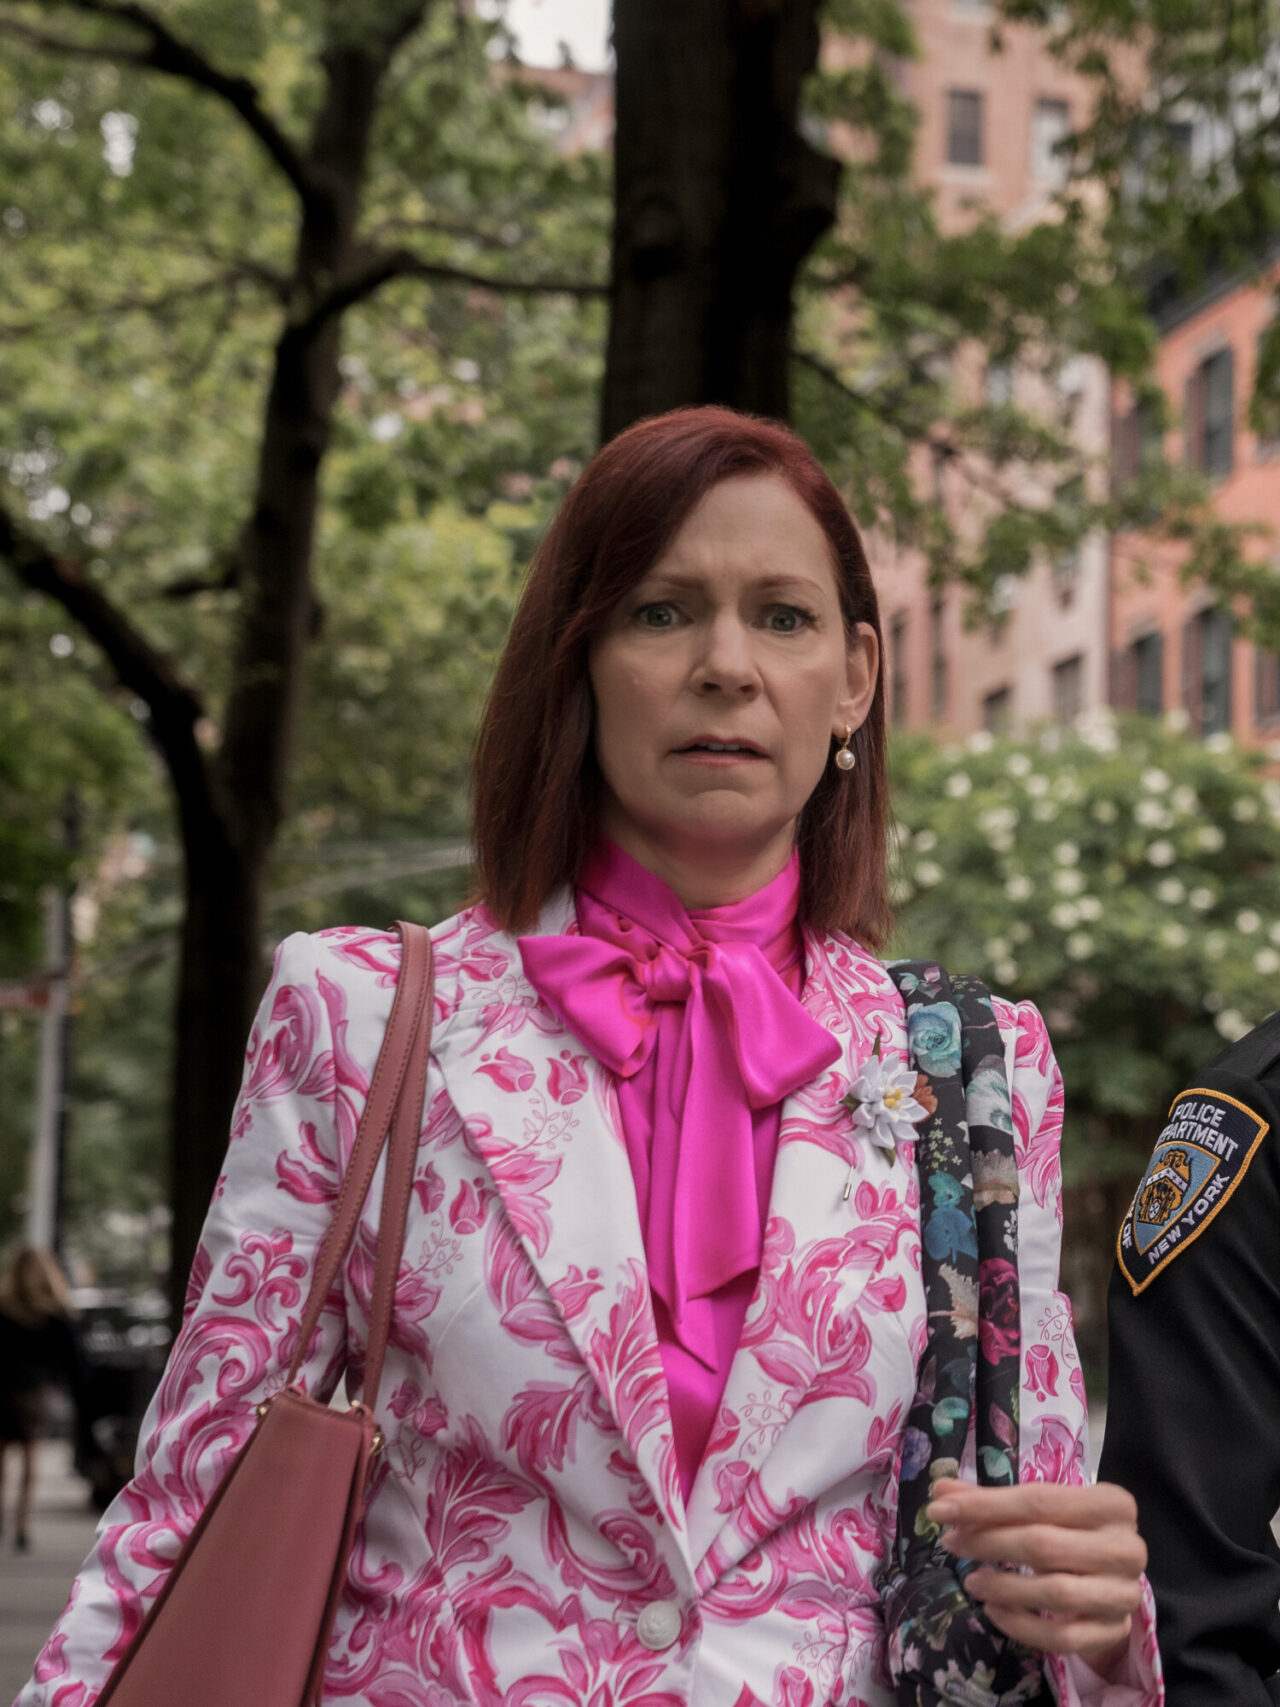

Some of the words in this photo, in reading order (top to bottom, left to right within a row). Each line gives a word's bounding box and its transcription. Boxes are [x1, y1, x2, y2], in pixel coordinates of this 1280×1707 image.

[1171, 1102, 1227, 1128] POLICE
[1154, 1120, 1239, 1162] EPARTMENT
[1148, 1225, 1181, 1265] NEW
[1181, 1173, 1231, 1226] YORK
